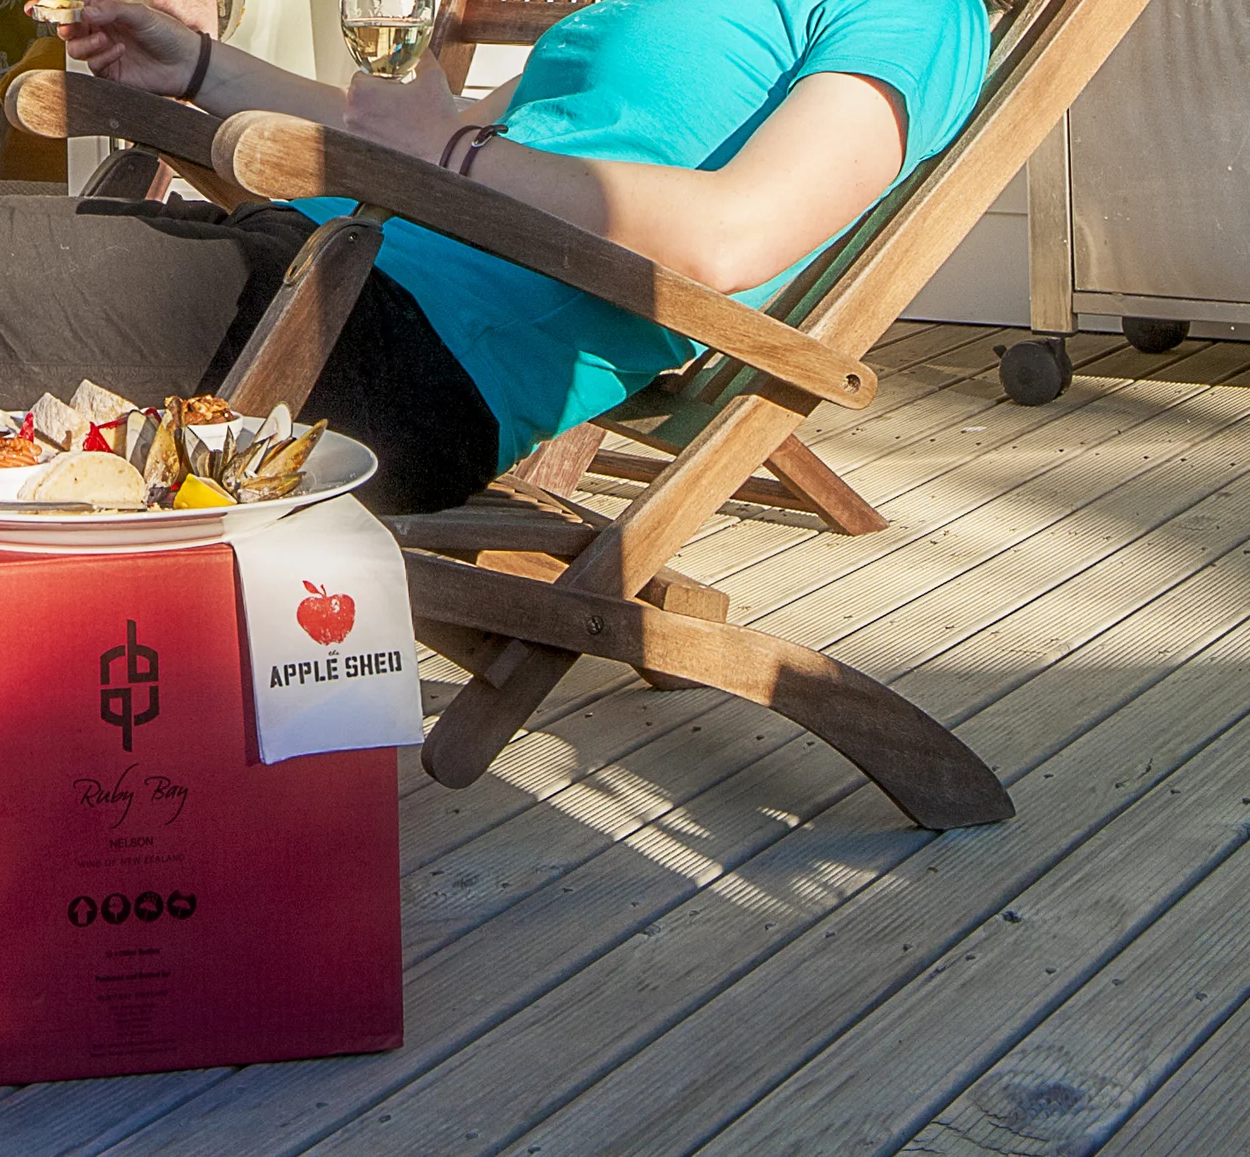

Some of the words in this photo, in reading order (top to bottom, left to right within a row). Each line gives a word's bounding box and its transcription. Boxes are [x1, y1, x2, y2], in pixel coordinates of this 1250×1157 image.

[270, 658, 339, 688] APPLE
[345, 651, 402, 678] SHED
[73, 763, 139, 829] Ruby
[144, 776, 189, 825] Bay
[110, 836, 154, 849] NELSON
